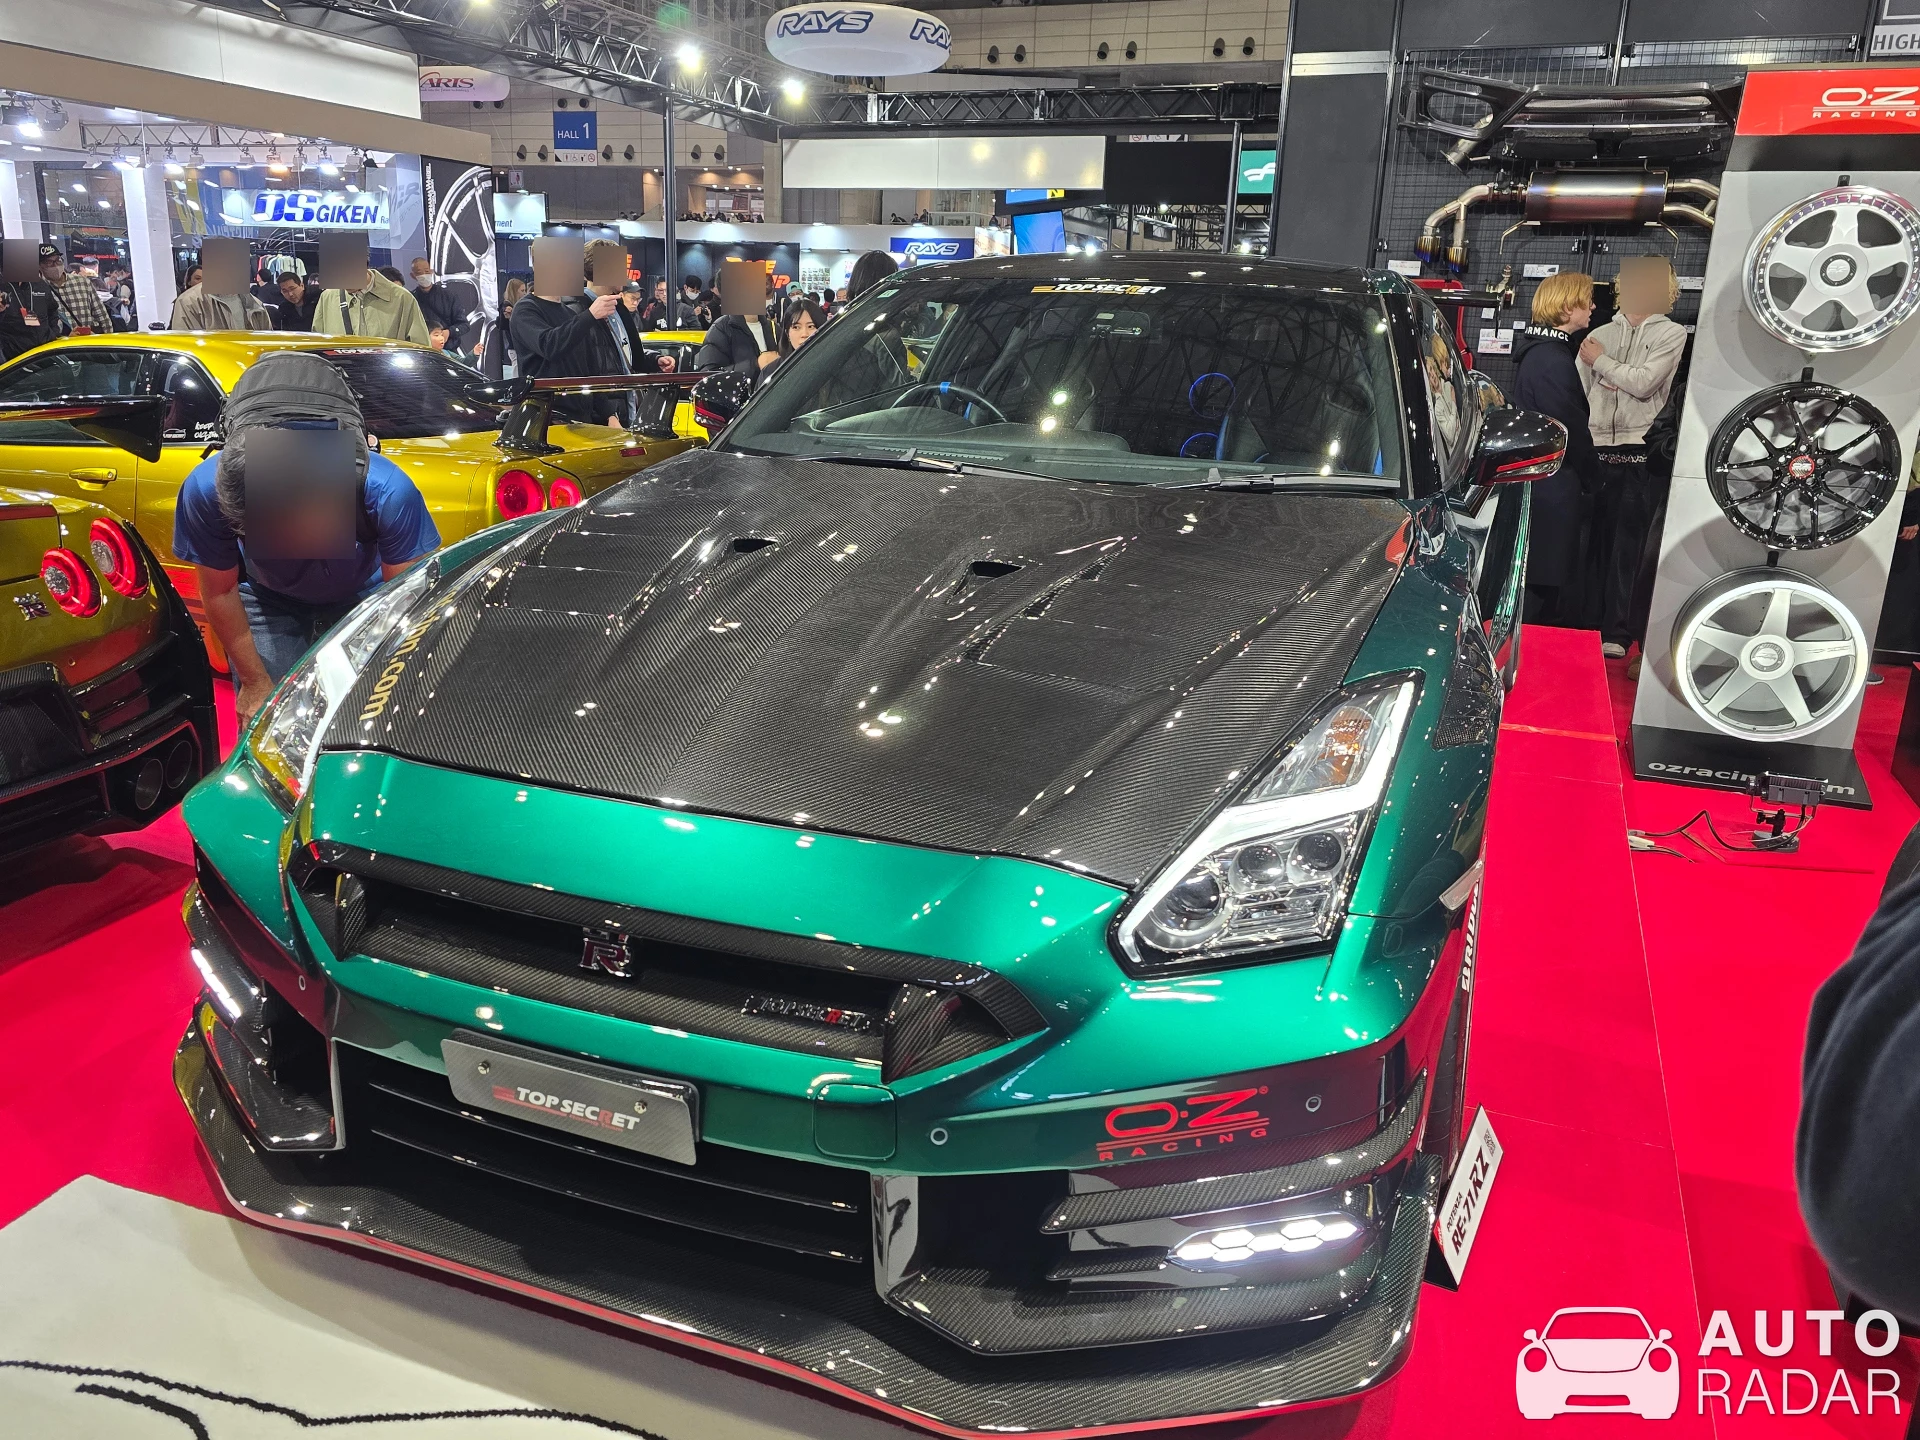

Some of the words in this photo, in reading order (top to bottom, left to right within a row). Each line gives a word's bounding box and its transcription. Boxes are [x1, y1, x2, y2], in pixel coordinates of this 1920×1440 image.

[777, 10, 873, 38] RAYS
[910, 18, 951, 50] RAY
[420, 72, 474, 89] ARIS
[1812, 110, 1917, 118] RACING
[557, 130, 579, 139] HALL
[582, 122, 590, 139] 1
[316, 204, 379, 224] GIKEN
[905, 242, 960, 256] RAYS
[1053, 283, 1095, 291] TOP
[1092, 284, 1167, 294] SECRET
[517, 1087, 560, 1108] TOP
[560, 1100, 640, 1130] SECRET
[1099, 1128, 1267, 1161] RACING
[1446, 1191, 1463, 1233] POTENZA
